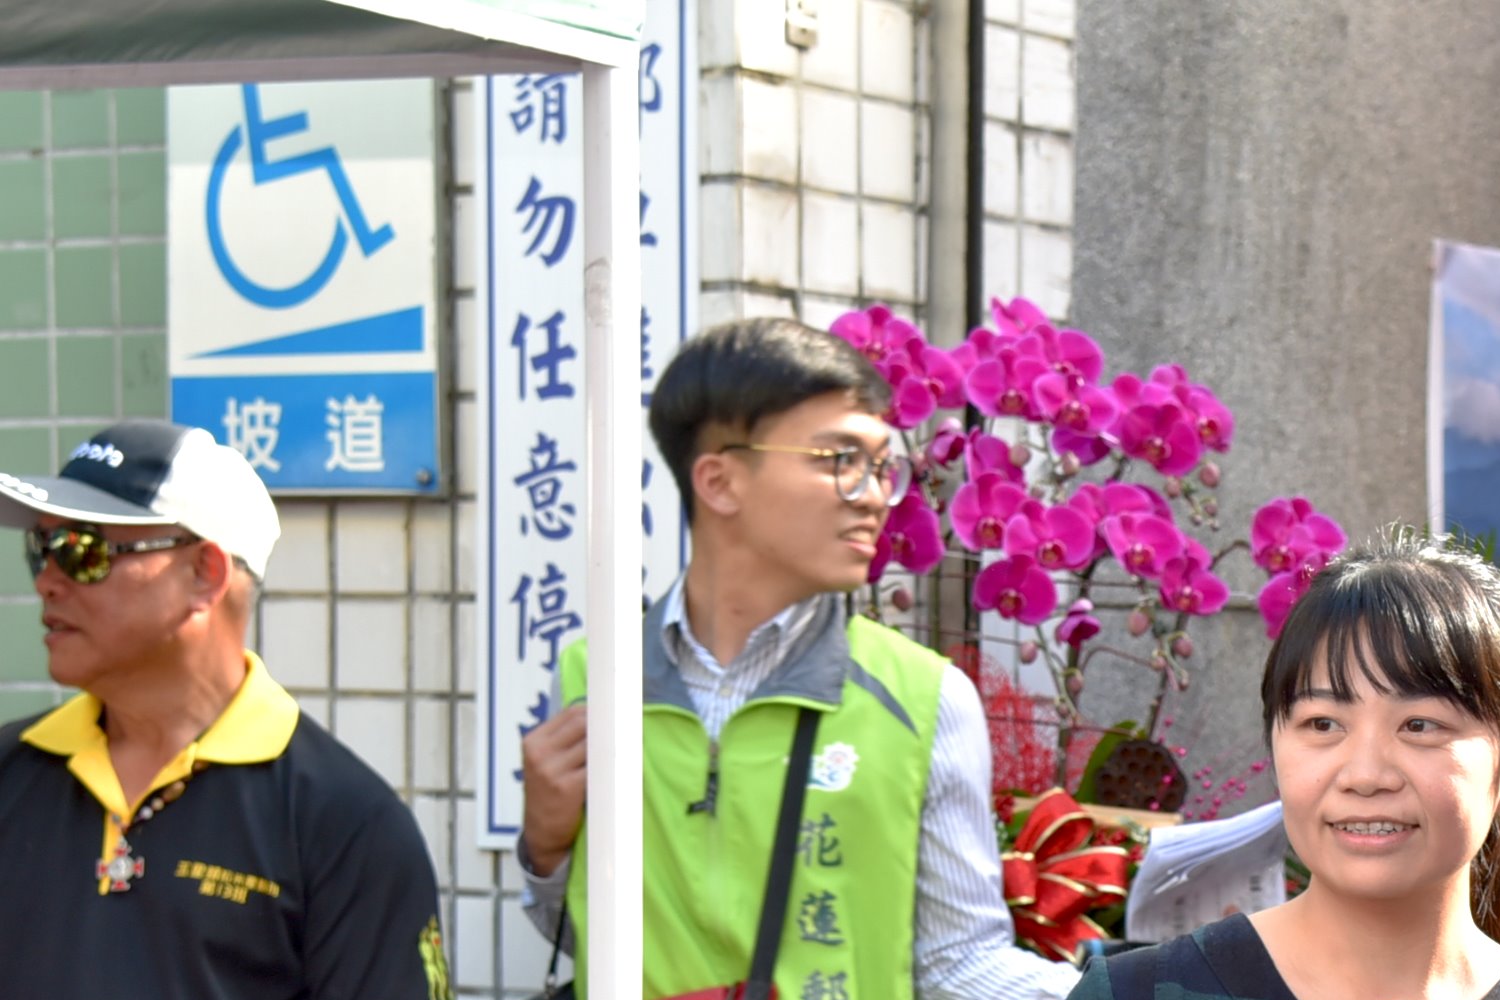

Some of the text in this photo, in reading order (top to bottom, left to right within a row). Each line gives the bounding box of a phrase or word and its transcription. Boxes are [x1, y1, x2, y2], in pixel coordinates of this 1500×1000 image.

[222, 395, 385, 473] 坡道
[508, 73, 583, 782] 請勿任意停
